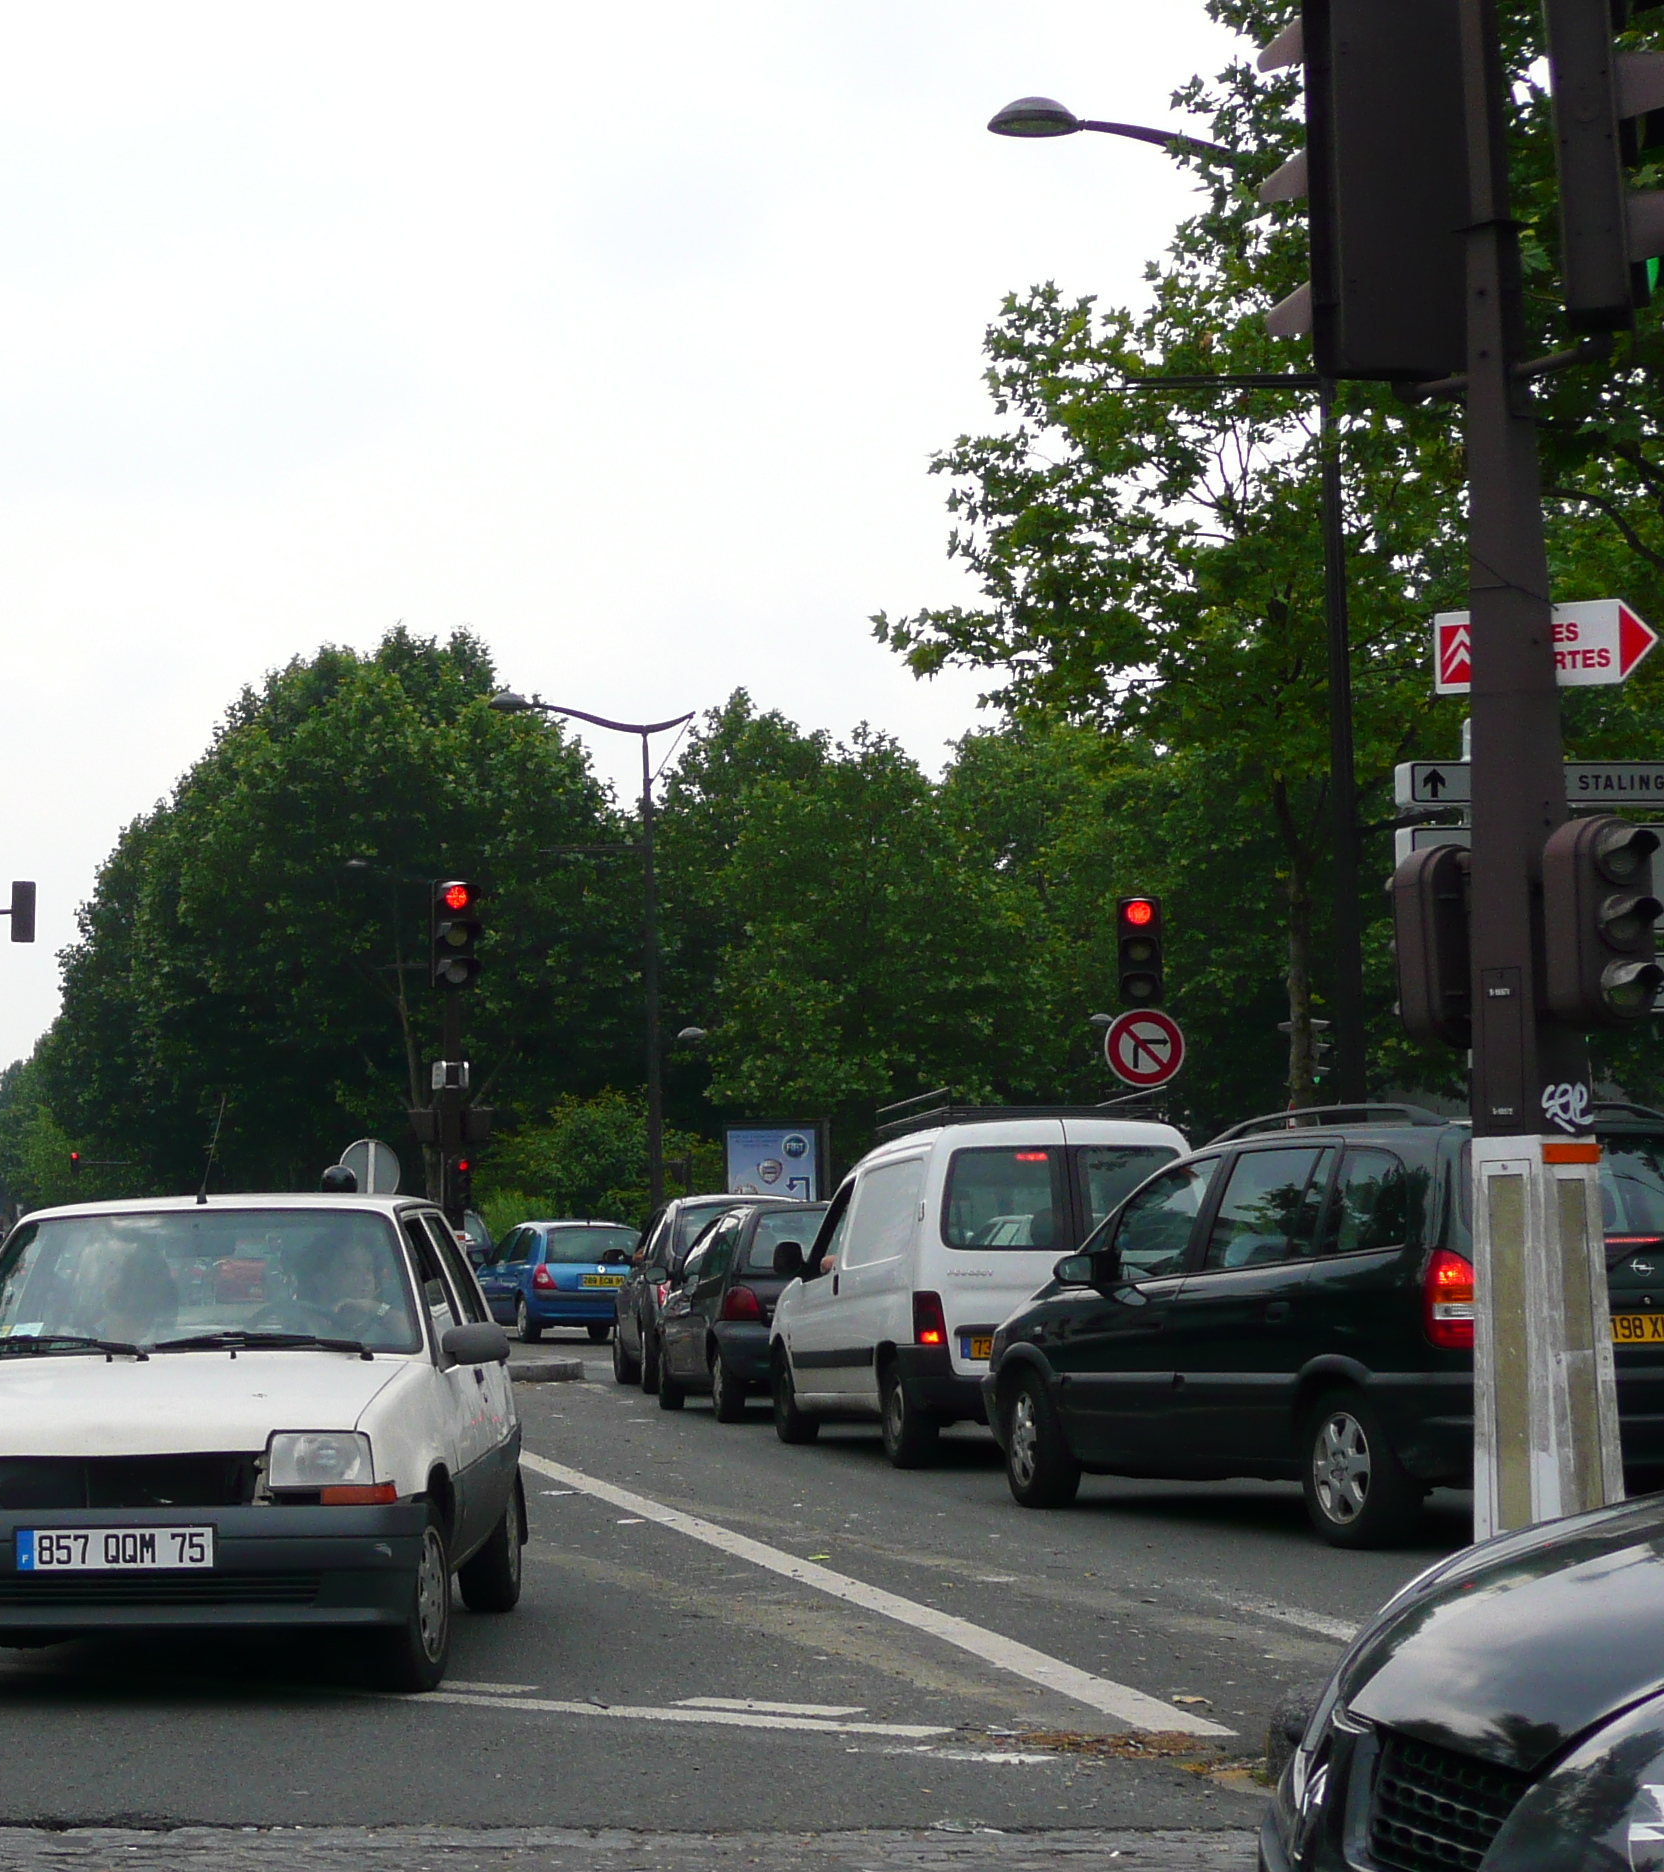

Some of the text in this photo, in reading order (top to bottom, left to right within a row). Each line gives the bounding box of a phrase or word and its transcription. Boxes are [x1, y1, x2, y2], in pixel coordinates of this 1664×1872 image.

[1612, 1316, 1645, 1339] 198
[38, 1534, 89, 1565] 857
[104, 1533, 156, 1564] QQM
[170, 1532, 205, 1563] 75
